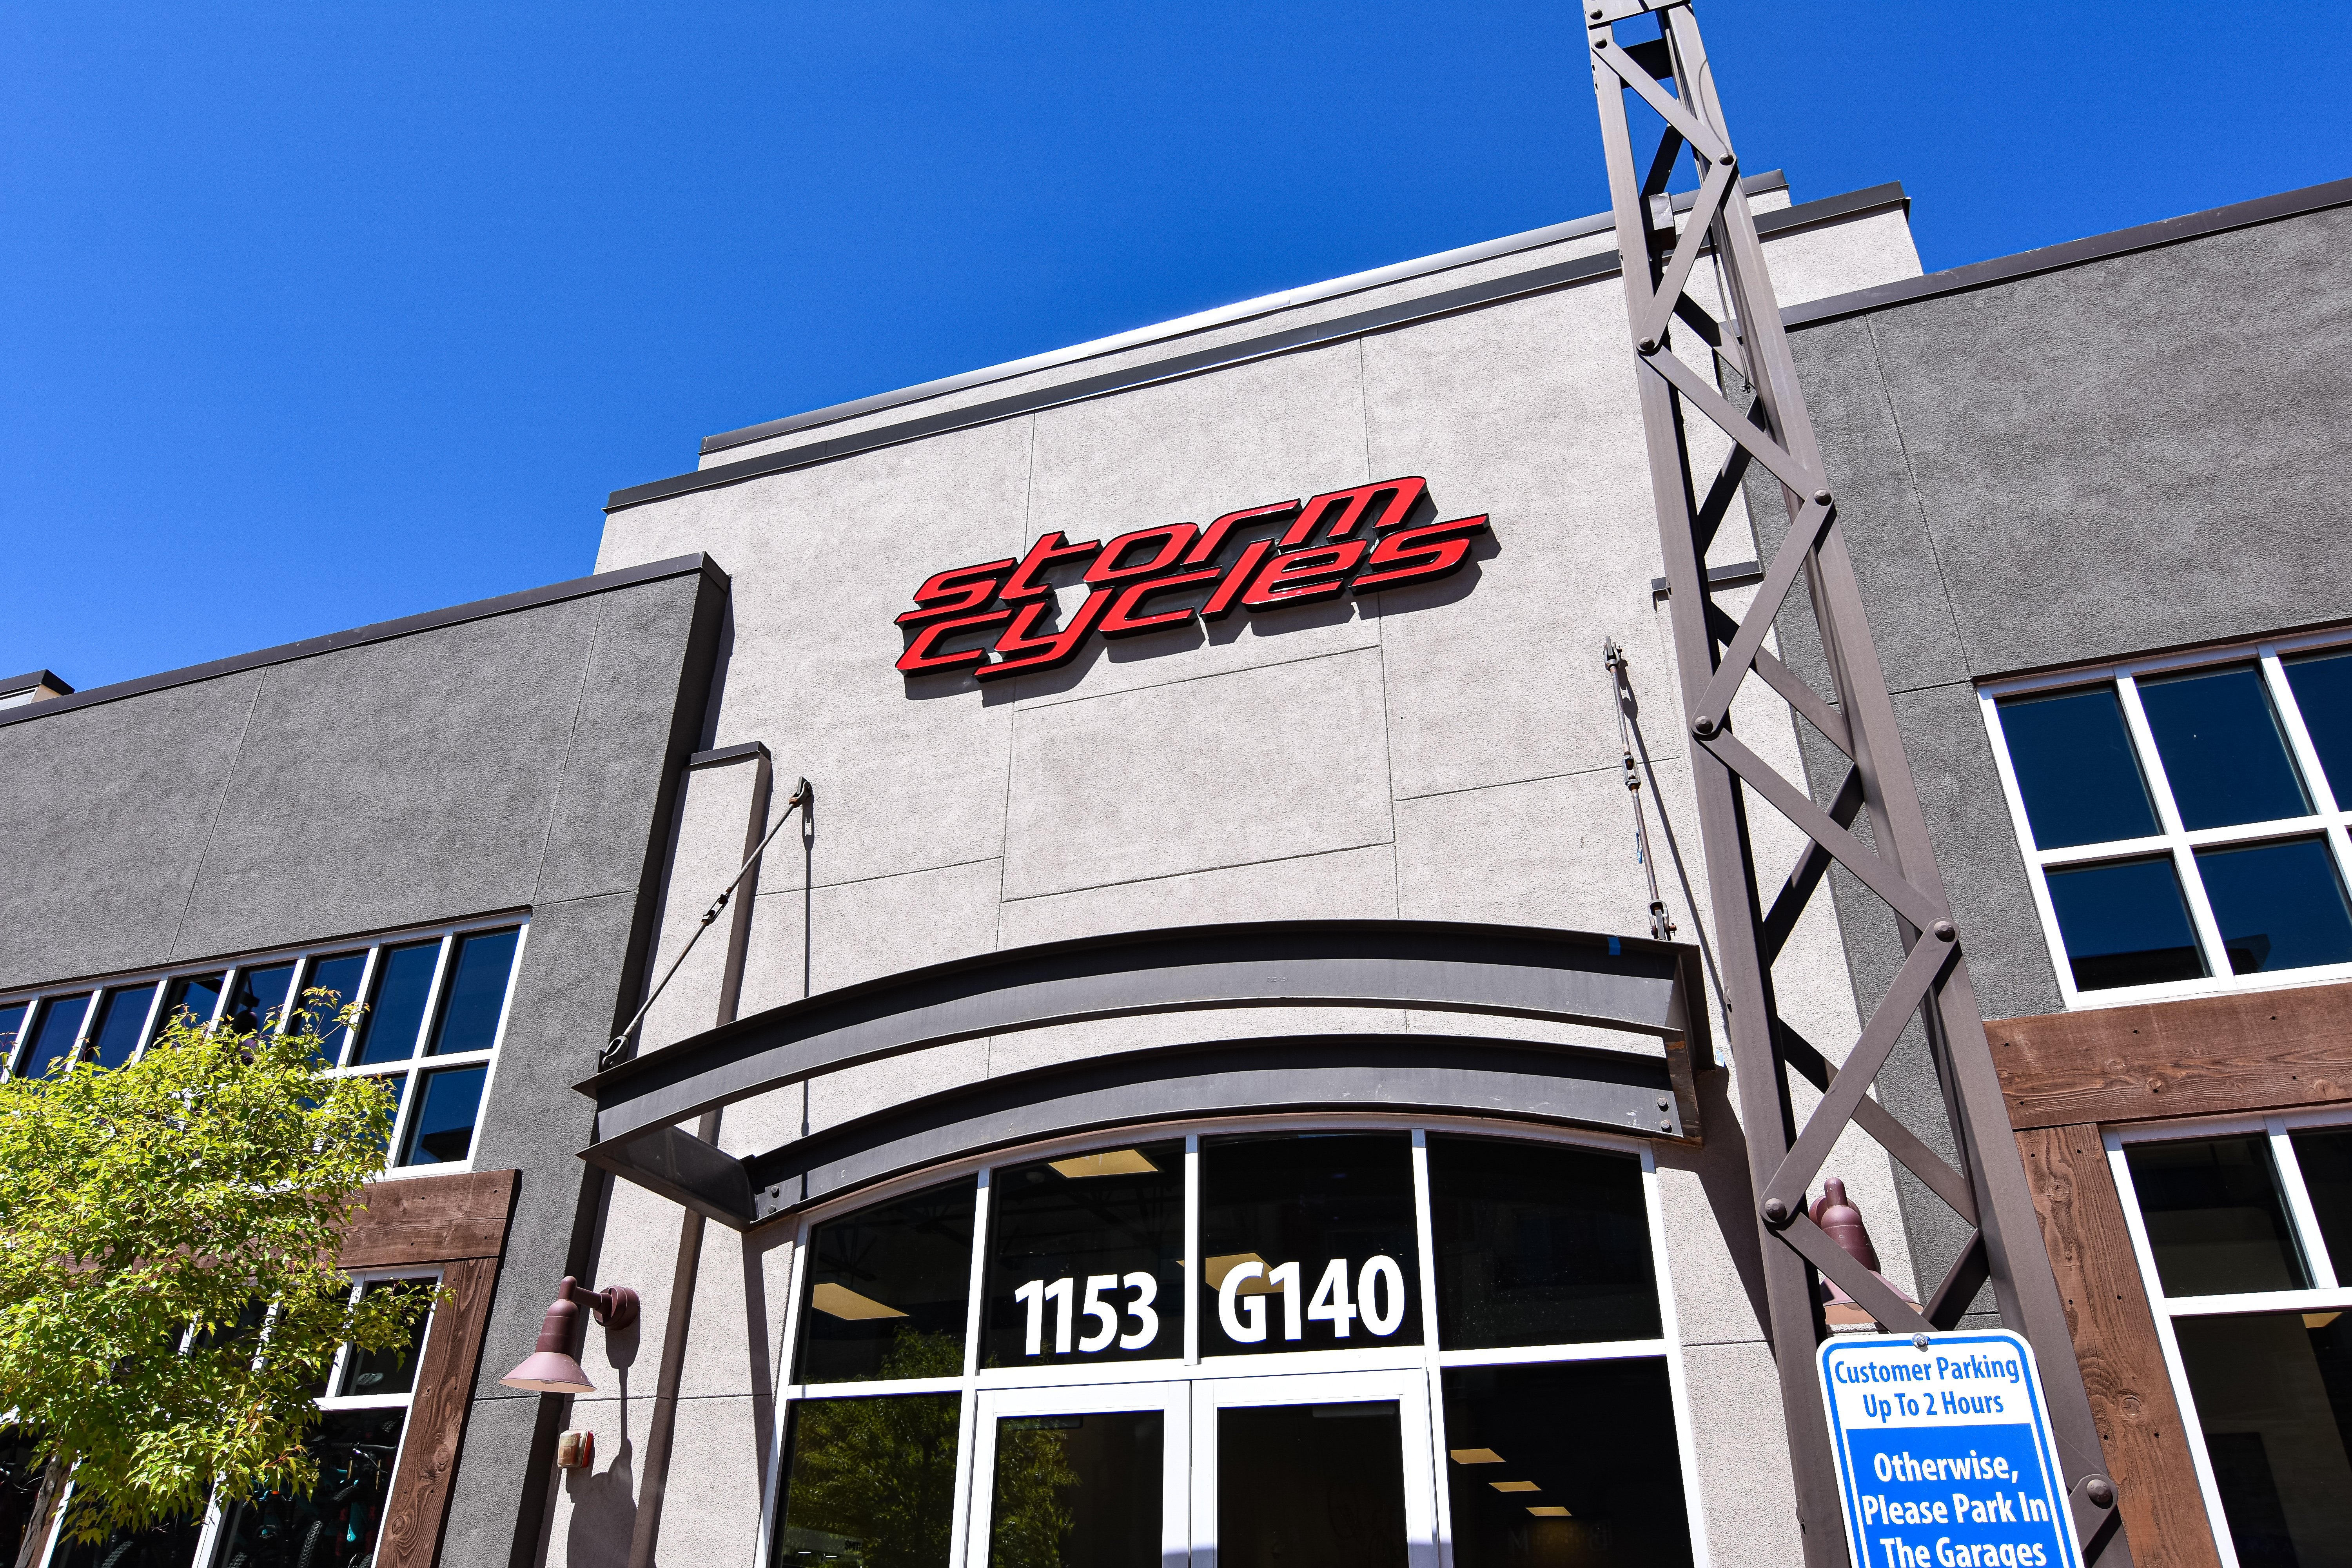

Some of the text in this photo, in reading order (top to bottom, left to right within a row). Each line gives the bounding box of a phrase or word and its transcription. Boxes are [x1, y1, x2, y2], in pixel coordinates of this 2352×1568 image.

[894, 475, 1429, 626] storm
[894, 513, 1490, 680] cycles
[1014, 1255, 1405, 1356] 1153 G140
[1835, 1354, 2020, 1384] Customer Parking
[1862, 1390, 2004, 1424] Up To 2 Hours
[1874, 1449, 2019, 1484] Otherwise,
[1862, 1490, 2049, 1525] Please Park In
[1879, 1536, 2047, 1568] The Garages
